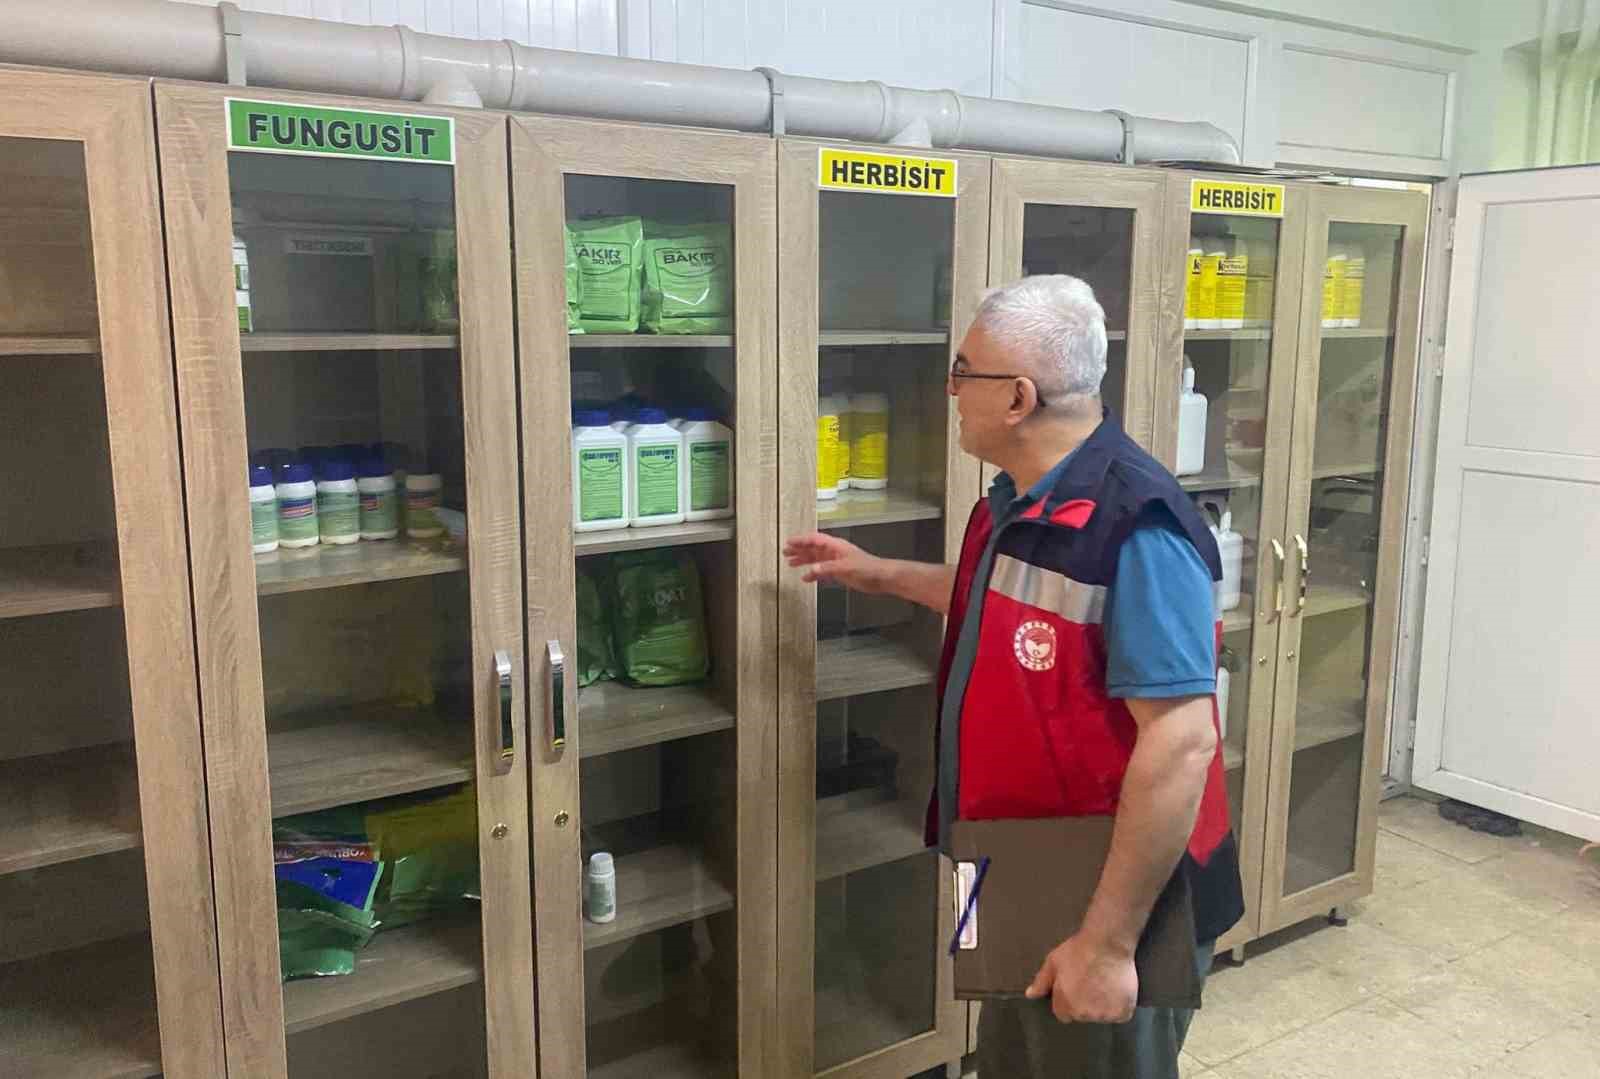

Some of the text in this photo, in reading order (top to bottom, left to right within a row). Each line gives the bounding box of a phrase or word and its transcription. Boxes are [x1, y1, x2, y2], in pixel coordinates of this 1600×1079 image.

[248, 113, 435, 155] FUNGUSİT
[832, 160, 945, 190] HERBİSİT
[1200, 187, 1276, 211] HERBİSİT
[576, 246, 620, 260] AKIR
[663, 252, 714, 265] BAKIR
